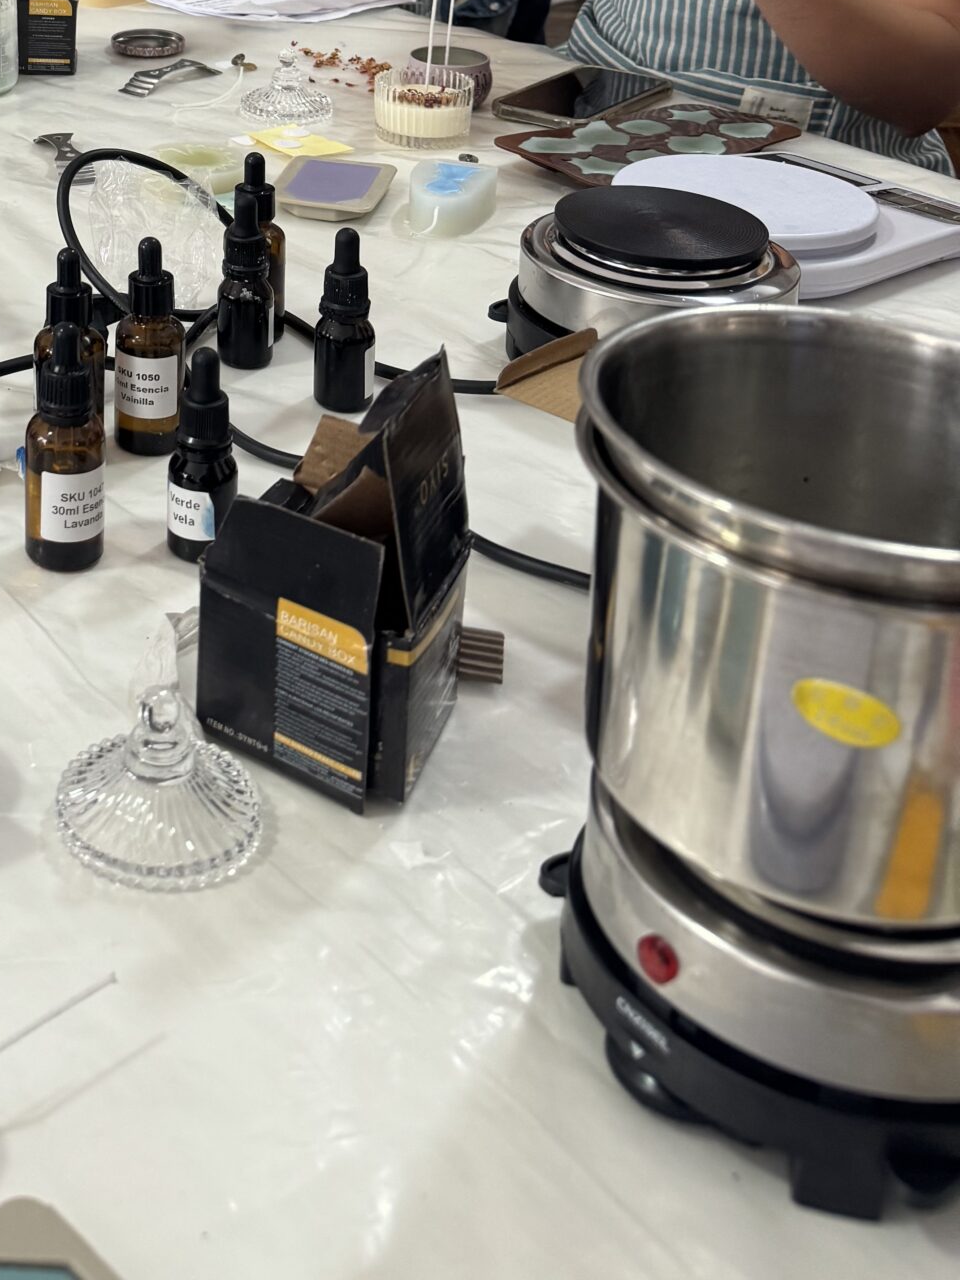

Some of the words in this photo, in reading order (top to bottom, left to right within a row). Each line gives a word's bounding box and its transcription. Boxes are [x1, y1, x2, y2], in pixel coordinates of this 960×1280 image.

[136, 373, 161, 382] 1050
[130, 383, 170, 394] Esencia
[120, 391, 155, 406] Vainilla
[60, 491, 86, 503] SKU
[170, 491, 200, 511] Verde
[51, 505, 80, 516] 30ml
[173, 512, 195, 527] vela
[281, 609, 338, 646] BARISAN
[280, 623, 323, 651] CANDY
